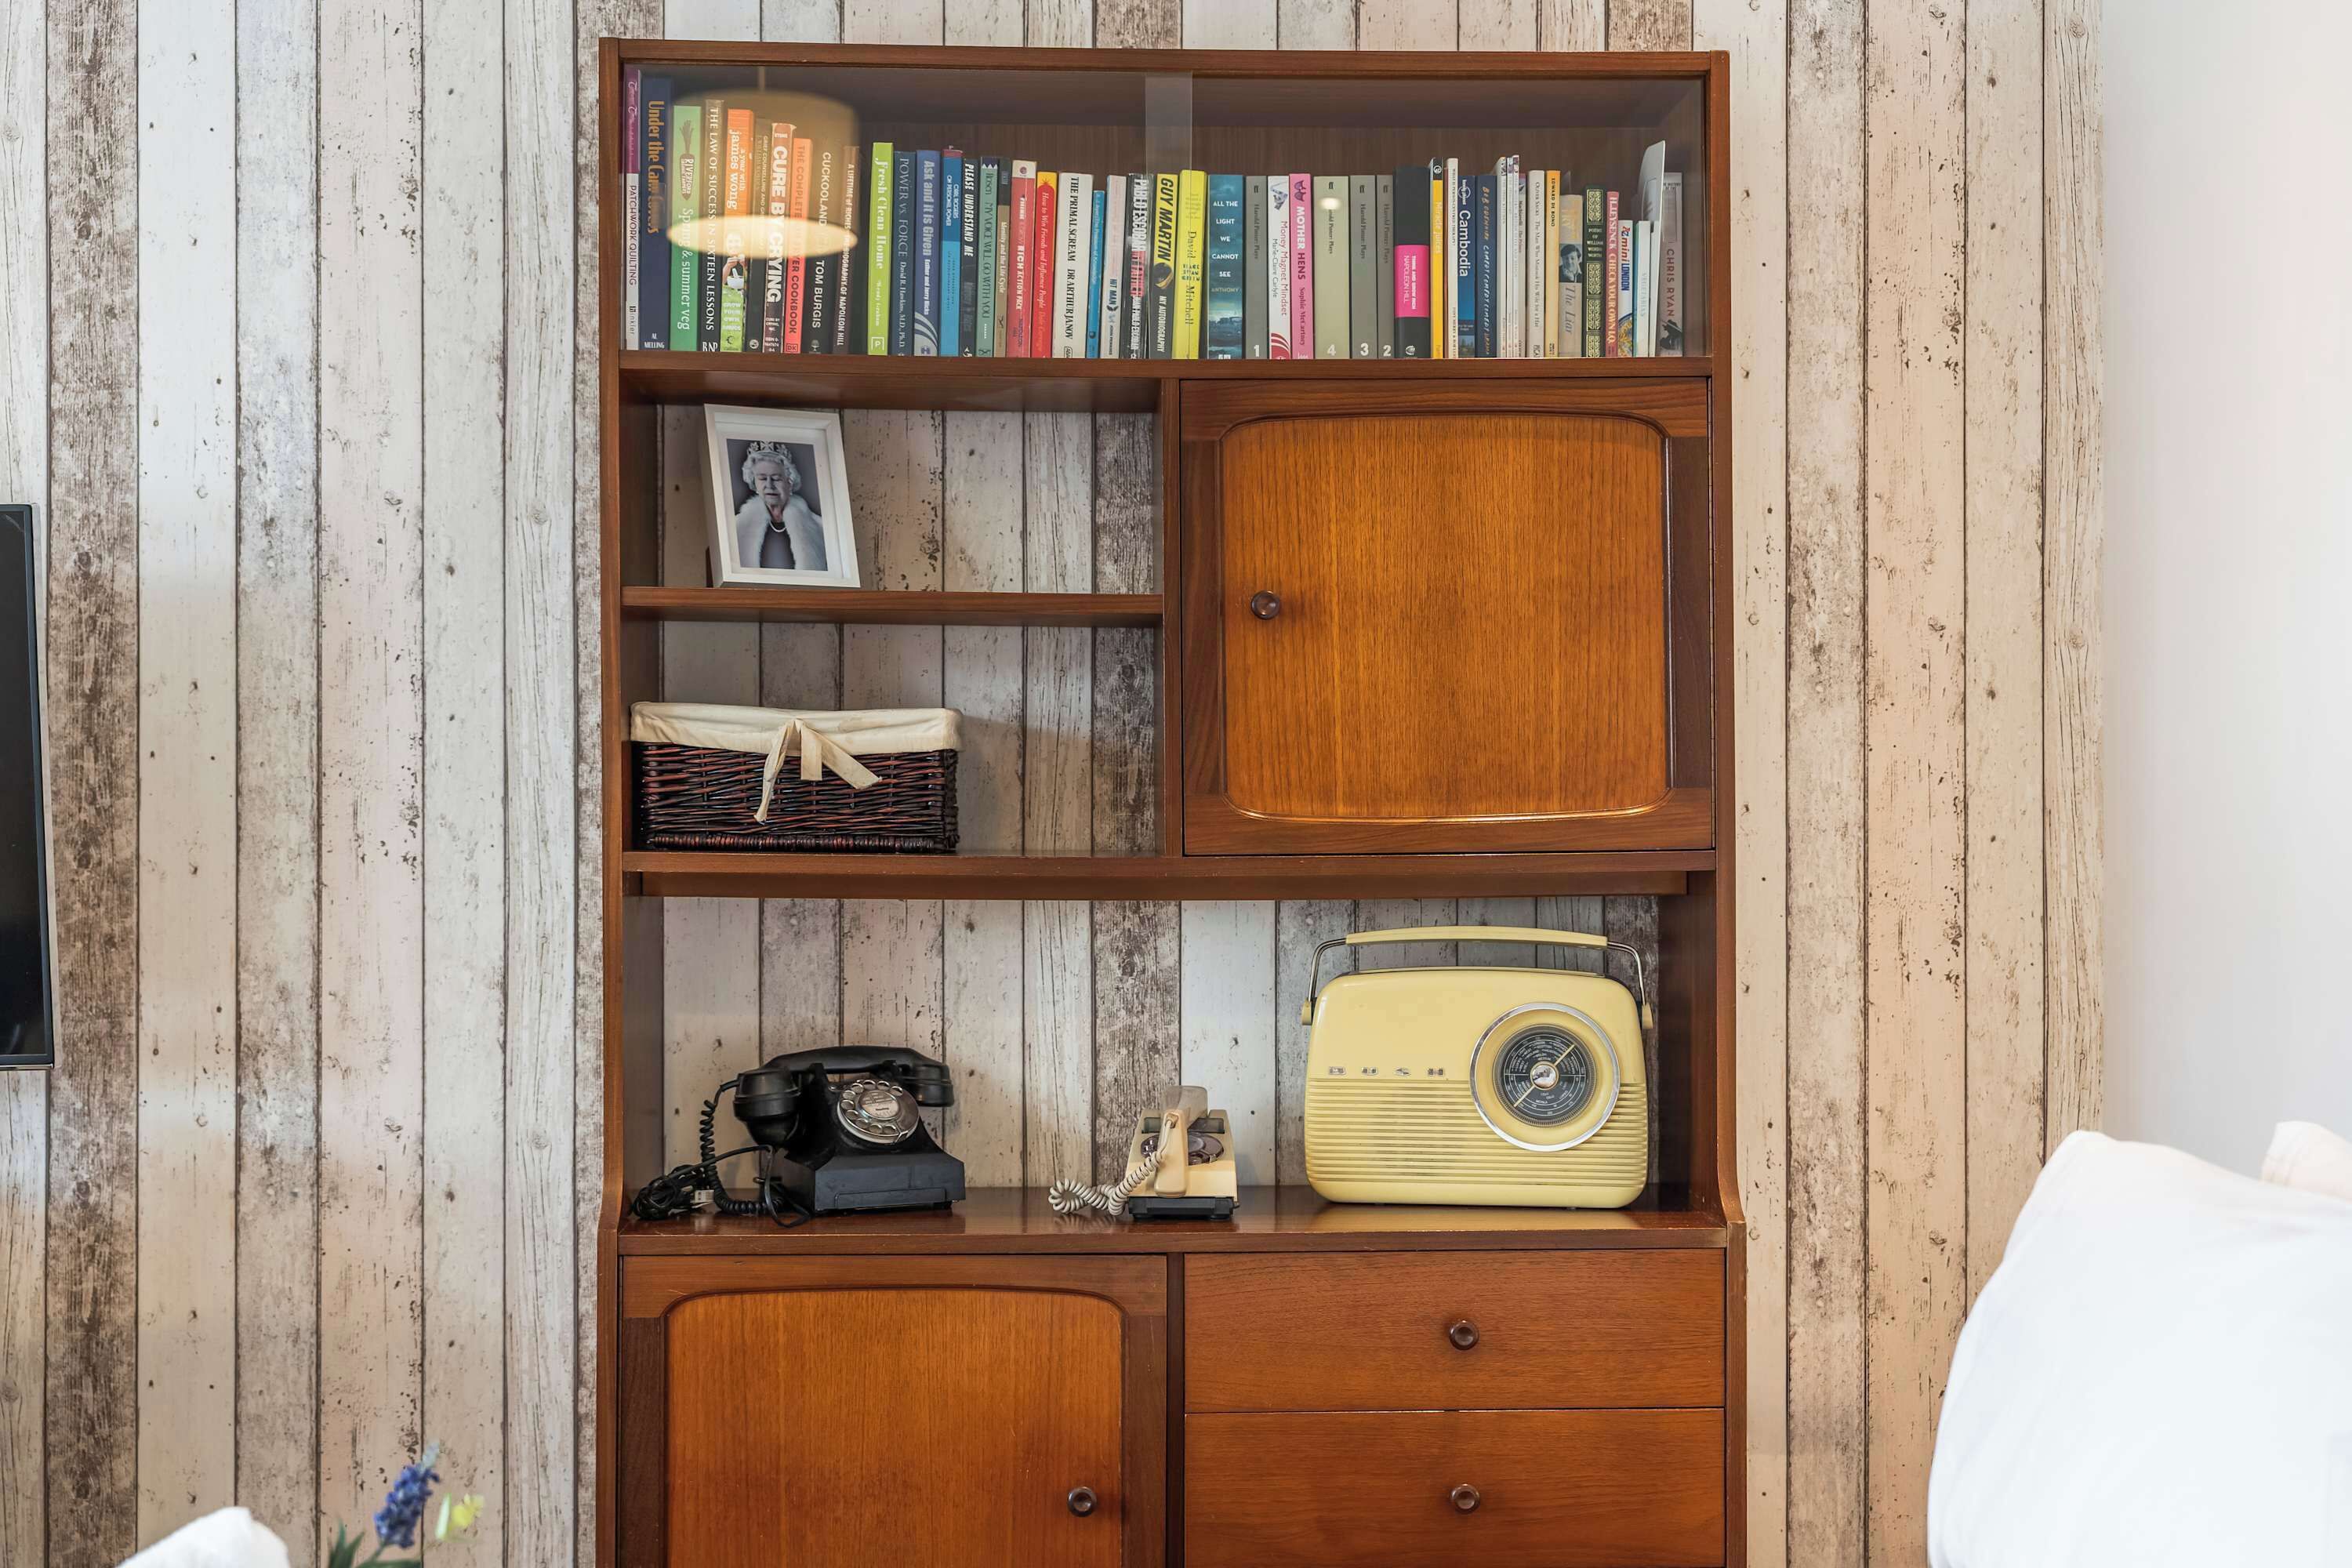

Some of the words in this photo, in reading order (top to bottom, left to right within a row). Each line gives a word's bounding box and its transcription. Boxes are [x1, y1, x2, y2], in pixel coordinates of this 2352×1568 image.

[648, 100, 666, 139] Under
[710, 107, 719, 129] THE
[648, 141, 665, 162] the
[710, 132, 718, 154] LAW
[728, 129, 742, 170] james
[796, 146, 805, 163] THE
[709, 157, 718, 172] OF
[771, 146, 789, 198] CURE
[874, 158, 889, 194] Fresh
[898, 158, 911, 200] POWER
[924, 160, 935, 180] Ask
[964, 163, 975, 191] PLEASE
[707, 174, 718, 220] SUCCESS
[727, 172, 740, 210] wong
[793, 166, 804, 219] COMPLETE
[818, 151, 832, 227] CUCKOOLAND
[846, 170, 855, 199] LIFETIME
[923, 181, 934, 202] and
[985, 172, 994, 195] Rosen
[1069, 176, 1080, 194] THE
[1132, 179, 1149, 209] PABLO
[1160, 177, 1174, 207] GUY
[629, 185, 638, 241] PATCHWORK
[876, 196, 887, 230] Clean
[984, 201, 993, 216] MY
[1041, 192, 1050, 205] How
[1069, 194, 1079, 227] PRIMAL
[1551, 201, 1556, 211] DE
[769, 201, 786, 230] BY
[844, 208, 852, 230] RICHES
[964, 193, 975, 242] UNDERSTAND
[983, 217, 993, 240] VOICE
[1040, 214, 1049, 227] Win
[1131, 209, 1149, 251] ESCOBAR
[1296, 205, 1305, 249] MOTHER
[898, 219, 909, 257] FORCE
[922, 225, 934, 256] Given
[1040, 227, 1049, 249] Friends
[1066, 228, 1077, 262] SCREAM
[1156, 207, 1174, 262] MARTIN
[1187, 230, 1197, 259] David
[1458, 209, 1471, 277] Cambodia
[628, 243, 637, 286] QUILTING
[681, 249, 694, 259] &
[706, 238, 717, 281] SIXTEEN
[875, 234, 887, 270] Home
[964, 245, 974, 257] ME
[982, 240, 993, 261] WILL
[1621, 237, 1630, 263] mini
[766, 233, 785, 303] CRYING
[815, 260, 826, 284] TOM
[840, 249, 851, 285] BIOGRAPHY
[982, 262, 992, 275] GO
[1036, 262, 1048, 289] Influence
[1066, 269, 1076, 281] DR
[1279, 251, 1288, 281] Magnet
[1297, 252, 1306, 281] HENS
[1403, 255, 1412, 290] NAPOLEON
[1608, 253, 1617, 283] CHECK
[1621, 263, 1630, 291] LONDON
[1667, 249, 1677, 283] CHRIS
[681, 261, 691, 307] summer
[982, 275, 992, 299] WITH
[1065, 281, 1076, 314] ARTHUR
[1109, 278, 1118, 290] HIT
[1109, 290, 1117, 306] MAN
[1271, 276, 1279, 299] Carlyle
[1298, 287, 1307, 310] Sophie
[1565, 287, 1577, 308] The
[1608, 281, 1617, 309] YOUR
[705, 285, 715, 331] LESSONS
[788, 274, 800, 334] COOKBOOK
[811, 286, 824, 329] BURGIS
[837, 296, 847, 332] NAPOLEON
[982, 299, 991, 318] YOU
[1036, 289, 1047, 310] People
[1158, 296, 1167, 306] MY
[1185, 285, 1196, 325] Mitchell
[1280, 283, 1289, 317] Mindset
[1666, 288, 1675, 318] RYAN
[677, 309, 691, 330] veg
[1064, 314, 1074, 339] JANOV
[1156, 305, 1167, 353] AUTOBIOGRAPHY
[1298, 311, 1308, 347] McCartney
[1565, 310, 1577, 336] Liar
[1608, 308, 1617, 330] OWN
[1131, 326, 1142, 350] ESCOBAR
[1327, 344, 1337, 357] 4
[1359, 343, 1370, 357] 3
[1383, 344, 1392, 358] 2
